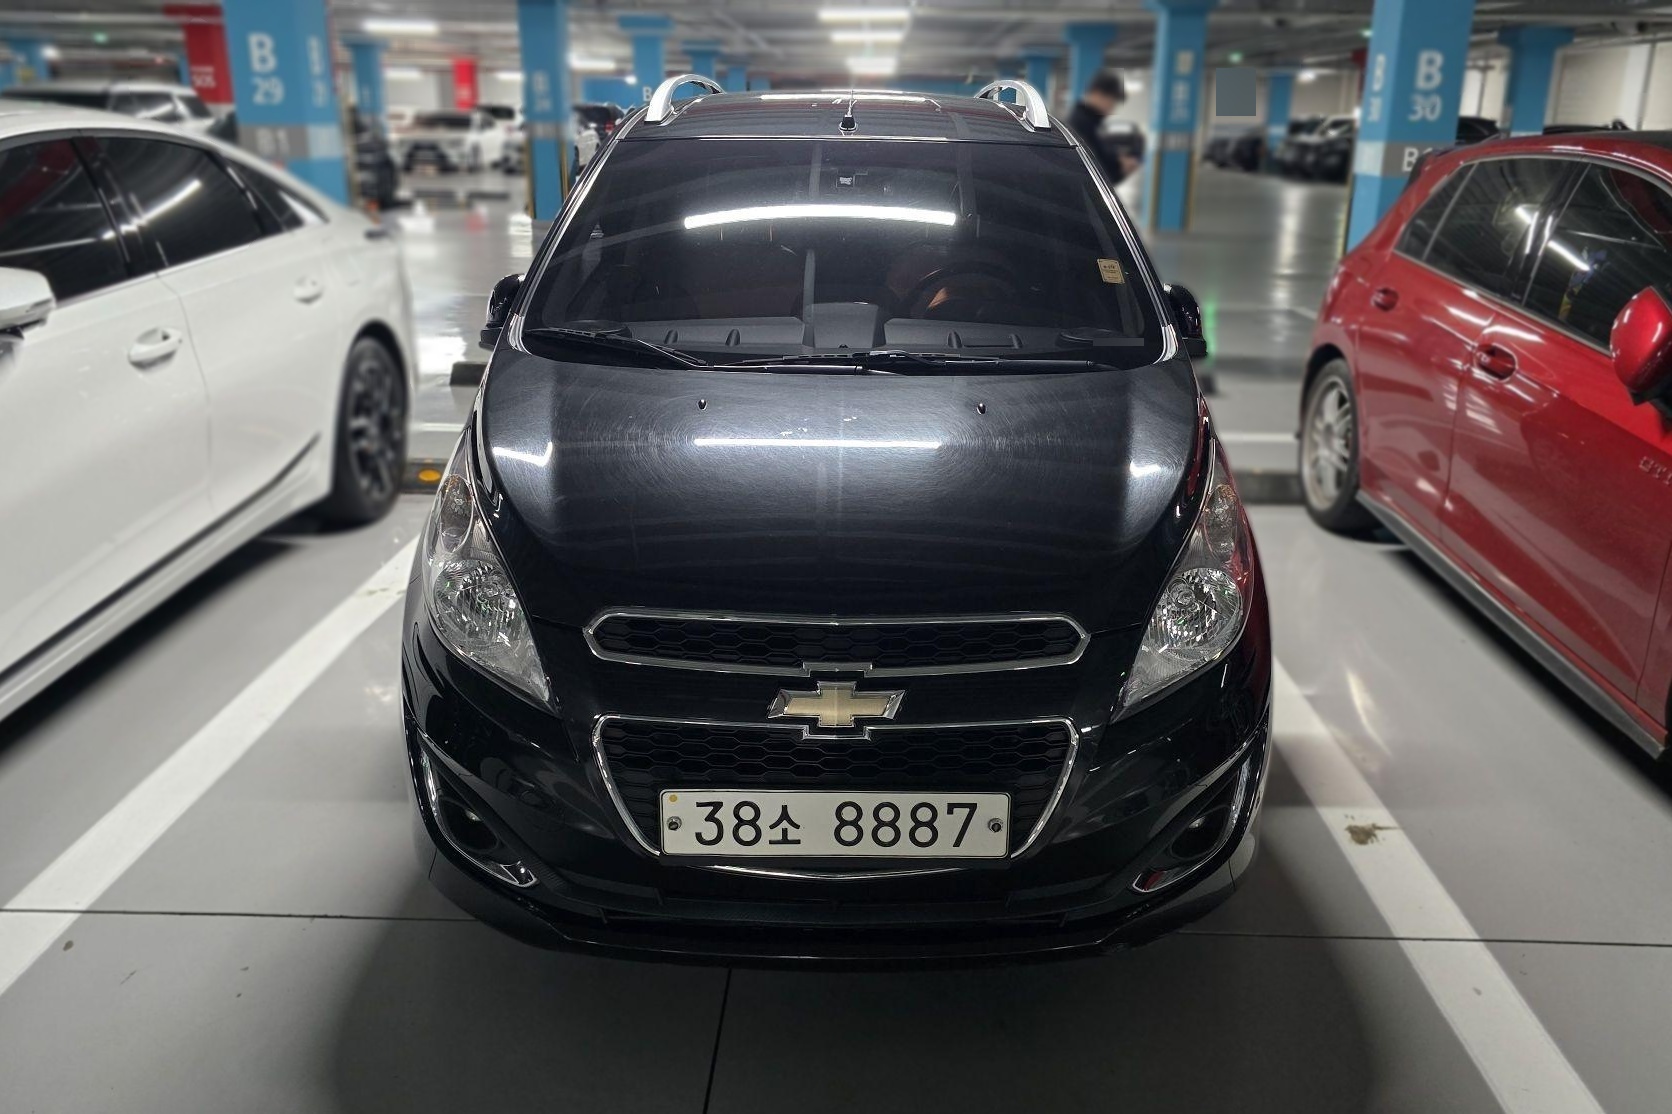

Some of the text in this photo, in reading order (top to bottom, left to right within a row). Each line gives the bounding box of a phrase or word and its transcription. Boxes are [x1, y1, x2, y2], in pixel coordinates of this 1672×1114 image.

[248, 32, 277, 73] B
[1416, 50, 1443, 90] B
[252, 77, 284, 105] 29
[1408, 94, 1441, 121] 30
[1401, 146, 1434, 172] B
[694, 800, 978, 848] 38소 8887
